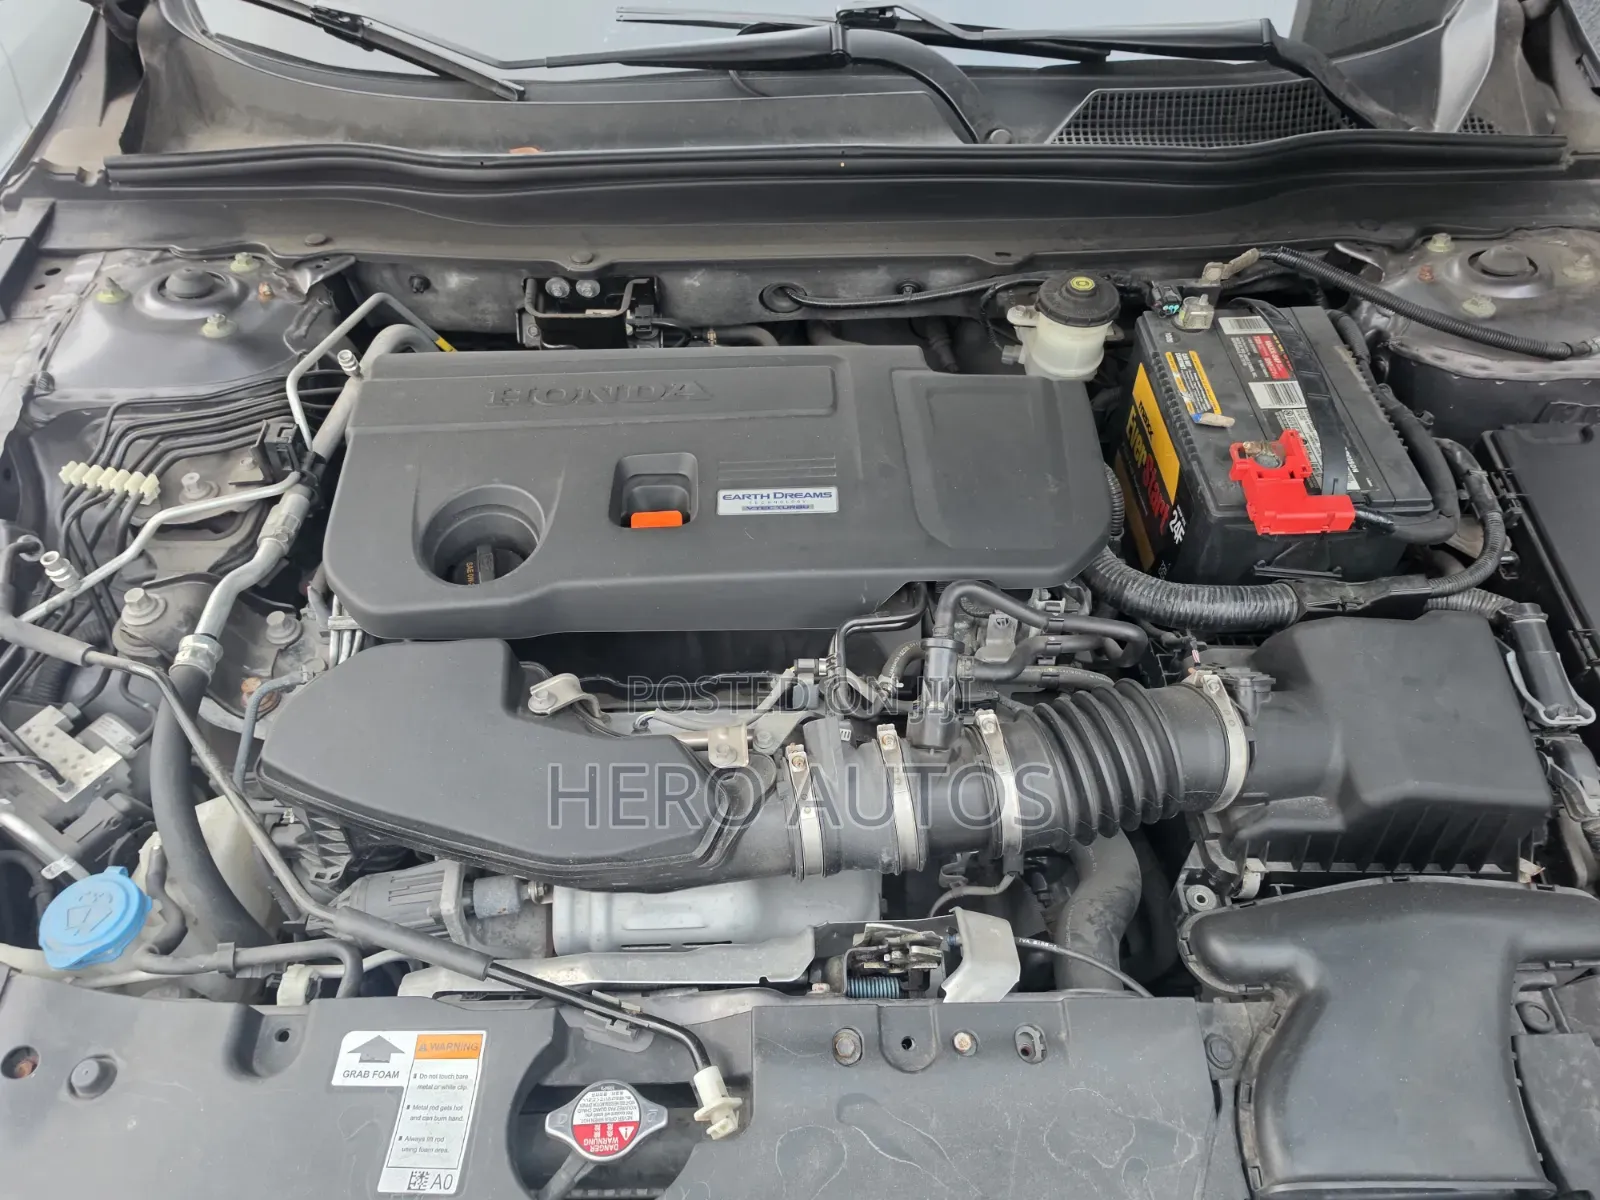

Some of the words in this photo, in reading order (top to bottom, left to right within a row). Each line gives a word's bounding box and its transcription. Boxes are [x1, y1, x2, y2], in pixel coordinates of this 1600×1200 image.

[485, 380, 714, 408] HONDA
[722, 493, 770, 501] EARTH
[773, 491, 833, 499] DREAMS
[1168, 509, 1186, 545] 24F
[466, 561, 474, 573] SAE
[429, 1042, 480, 1052] WARNING
[342, 1070, 370, 1079] GRAB
[372, 1070, 400, 1079] FOAM
[412, 1104, 429, 1112] Metal
[404, 1135, 426, 1144] Always
[401, 1146, 417, 1154] using
[418, 1146, 434, 1154] foam
[590, 1143, 619, 1153] DANGER
